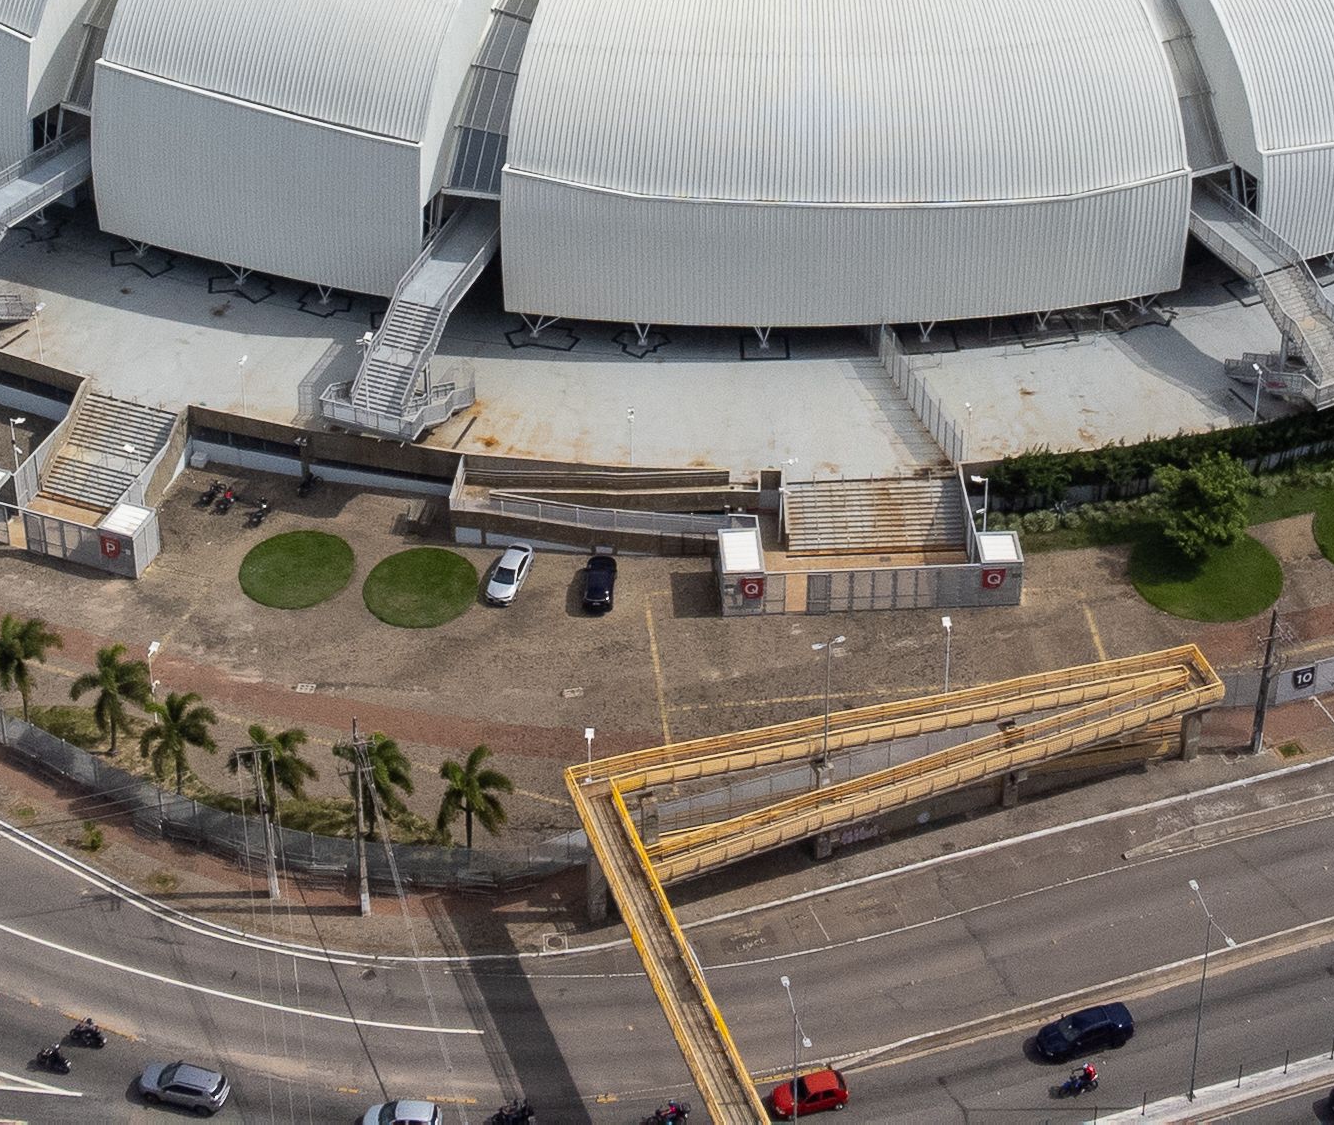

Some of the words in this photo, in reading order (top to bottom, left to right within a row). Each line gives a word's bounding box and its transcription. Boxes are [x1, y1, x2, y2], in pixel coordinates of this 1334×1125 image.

[106, 542, 116, 553] P
[987, 572, 1002, 585] Q
[744, 583, 759, 596] Q
[1296, 673, 1313, 685] 10
